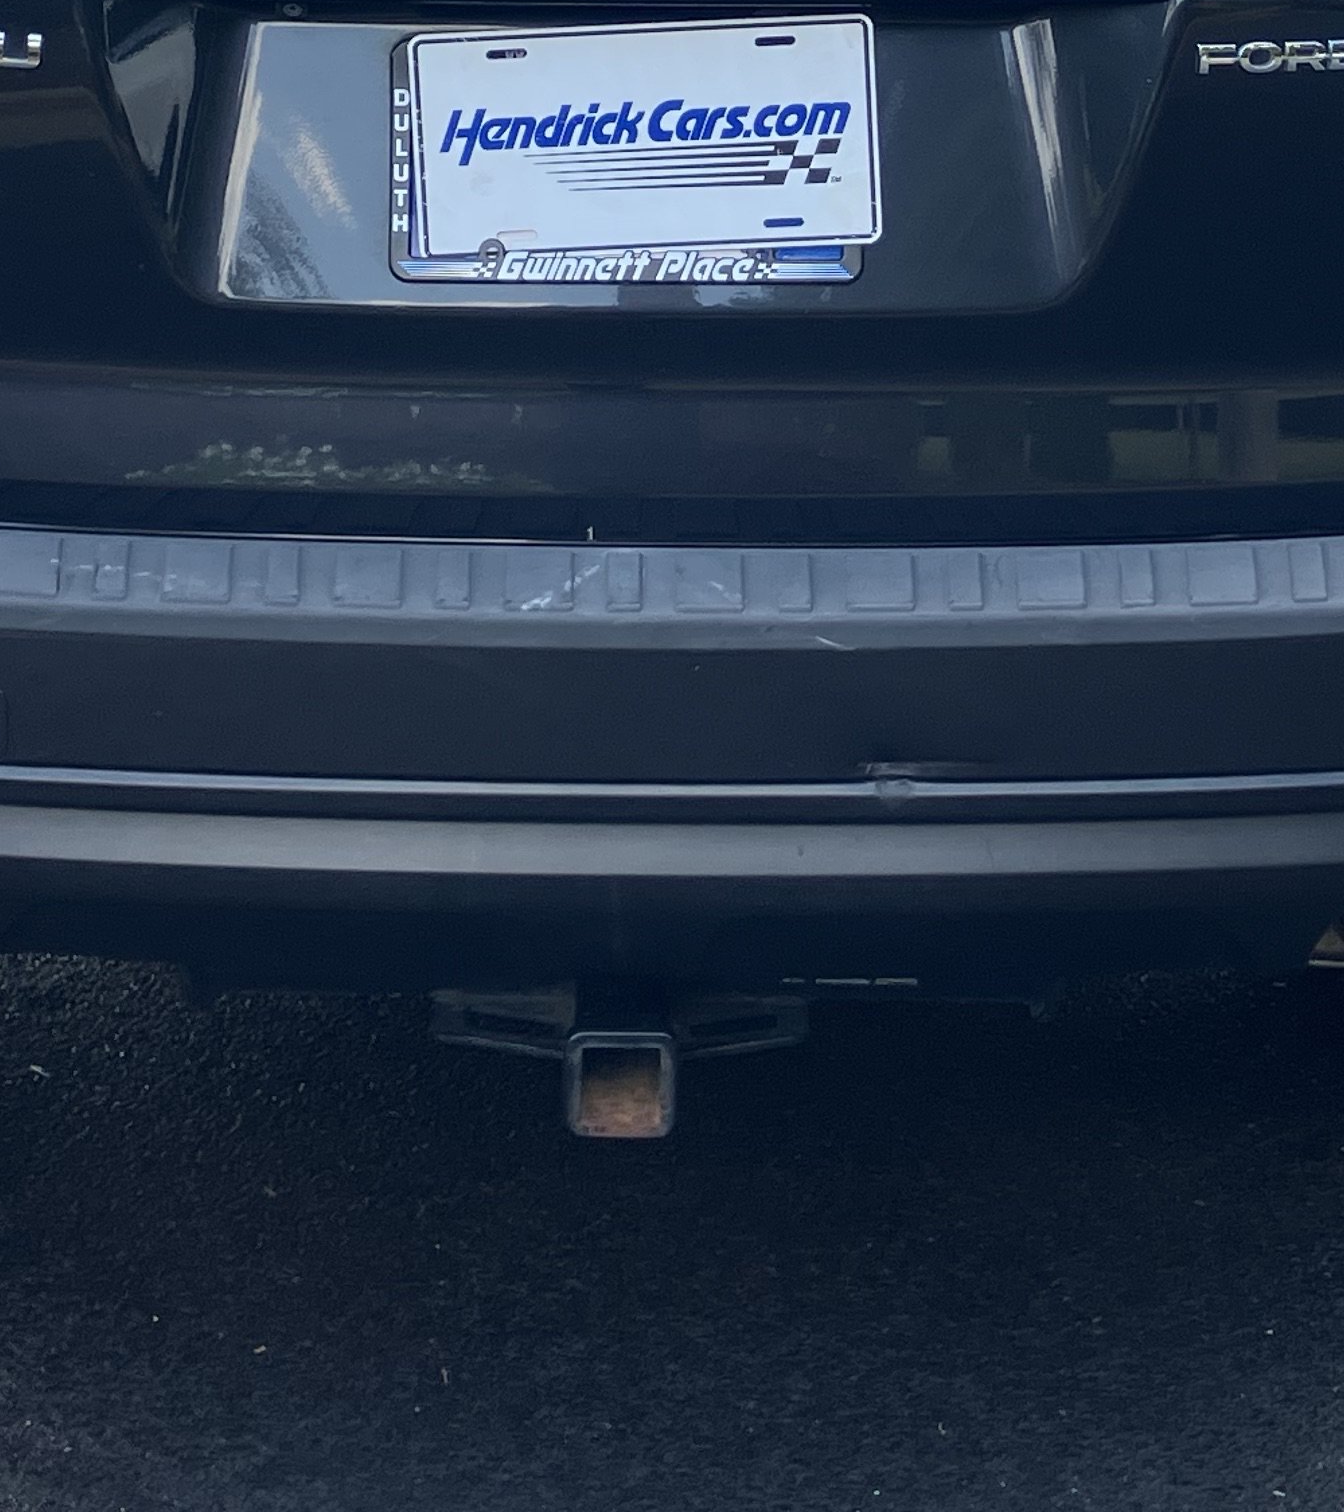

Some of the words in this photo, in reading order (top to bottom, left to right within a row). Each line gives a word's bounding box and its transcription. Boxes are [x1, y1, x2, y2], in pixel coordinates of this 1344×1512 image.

[392, 88, 411, 233] DULUTH
[497, 250, 654, 282] Gwinnett
[656, 250, 757, 282] Place
